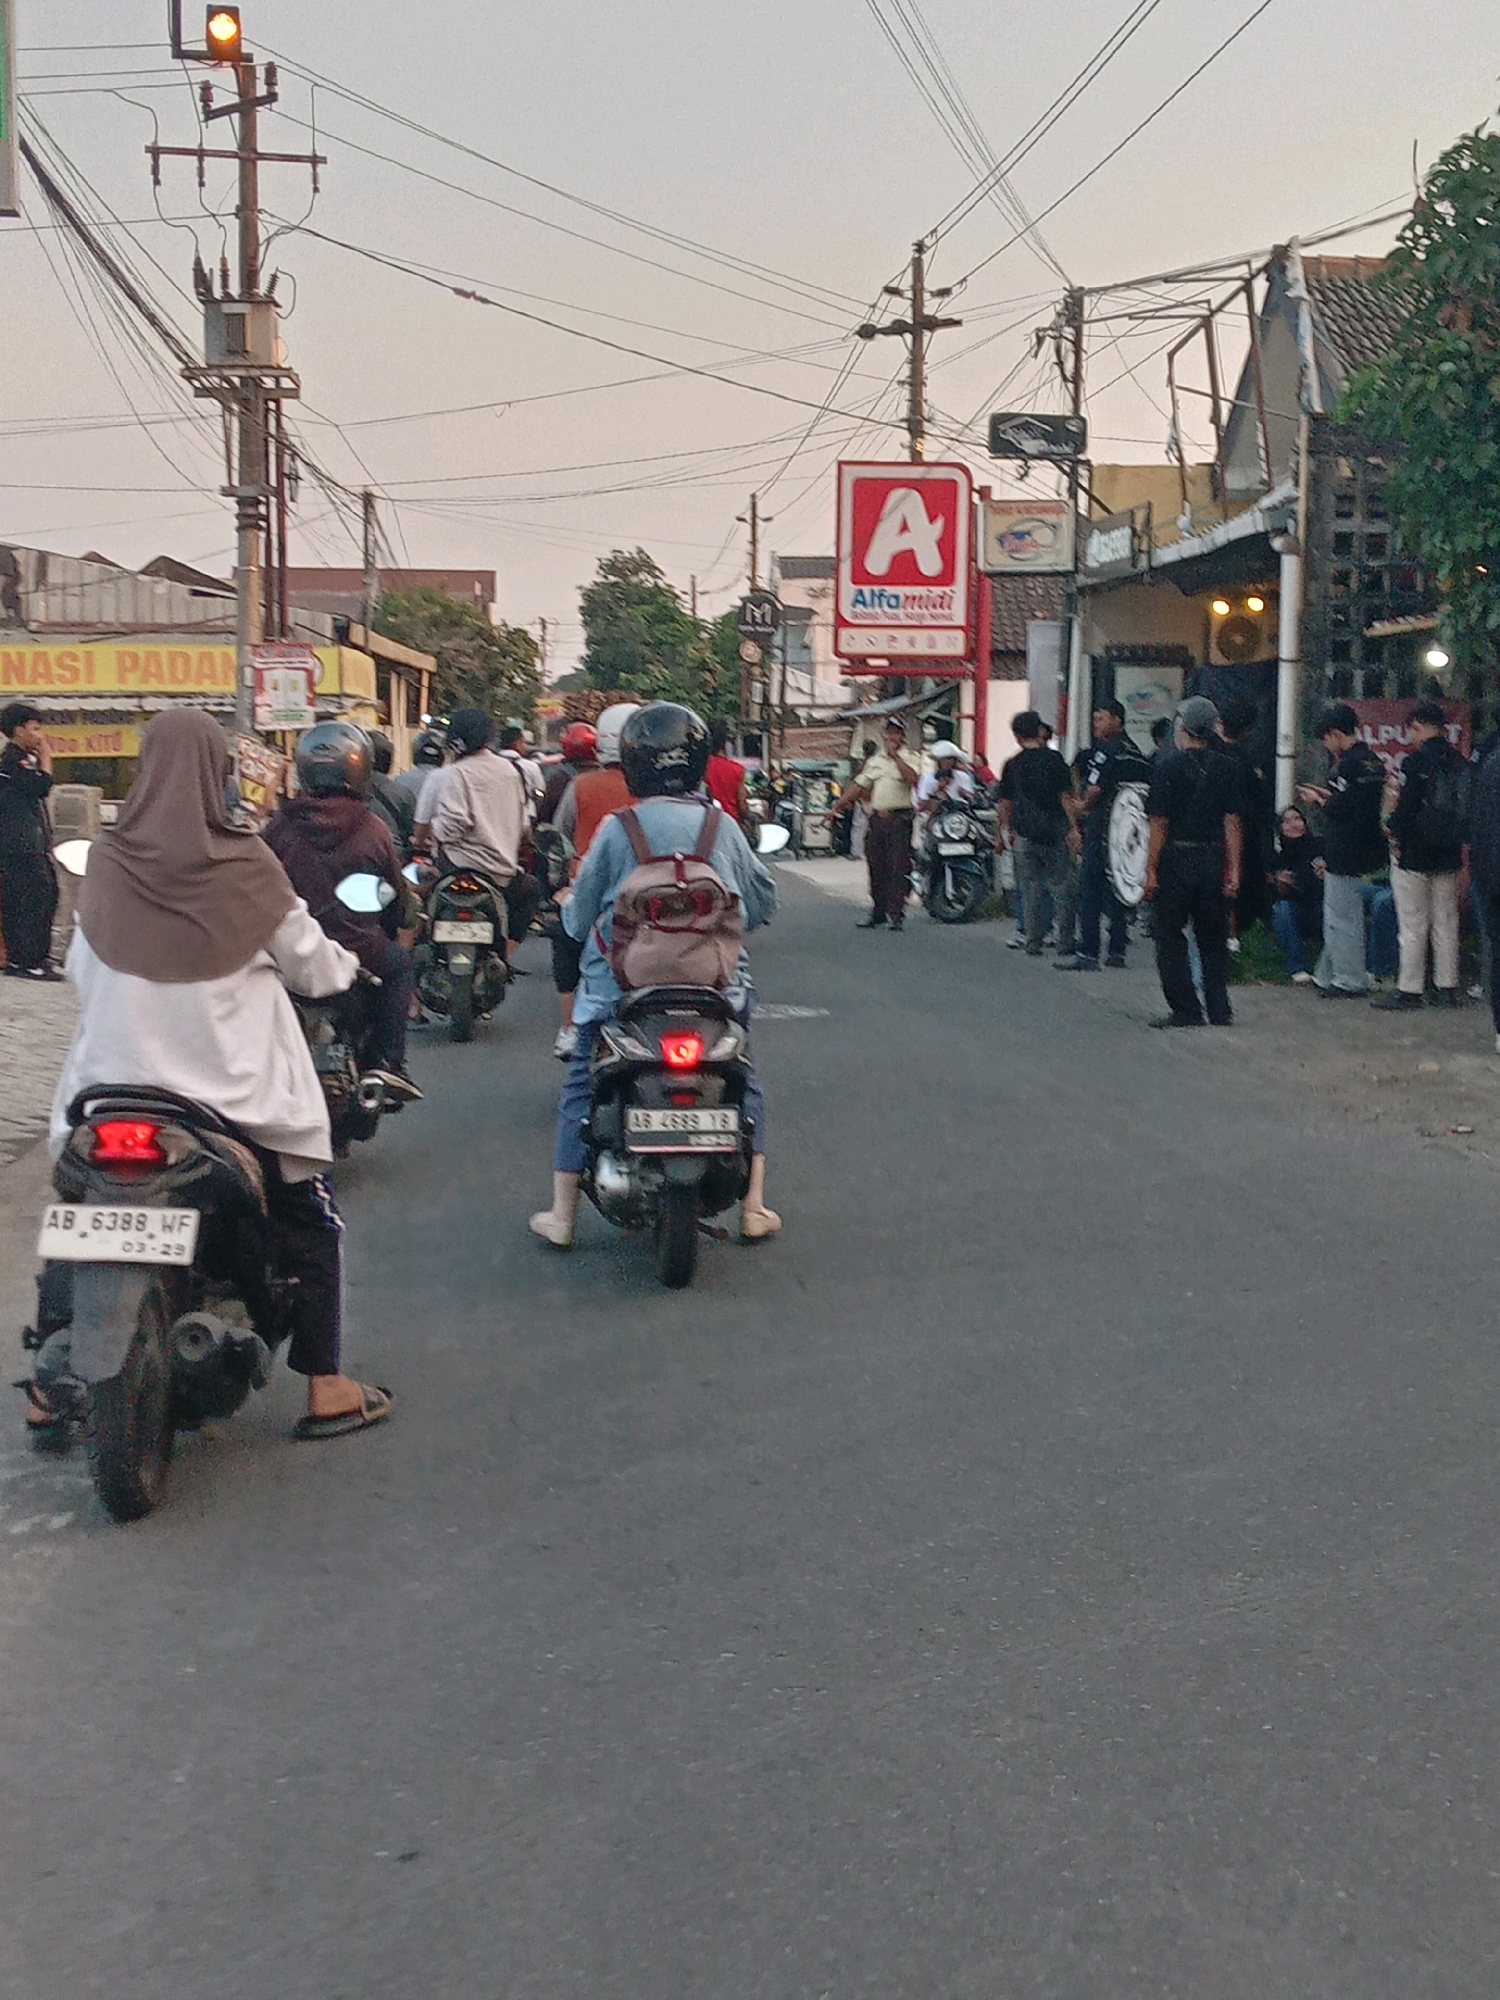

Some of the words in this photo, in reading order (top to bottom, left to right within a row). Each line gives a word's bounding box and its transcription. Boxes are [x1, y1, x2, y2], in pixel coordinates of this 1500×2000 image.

[851, 588, 956, 611] Alfamidi
[1, 650, 95, 686] NASI
[116, 649, 238, 687] PADAN
[46, 1209, 76, 1230] AB
[91, 1211, 149, 1232] 6388
